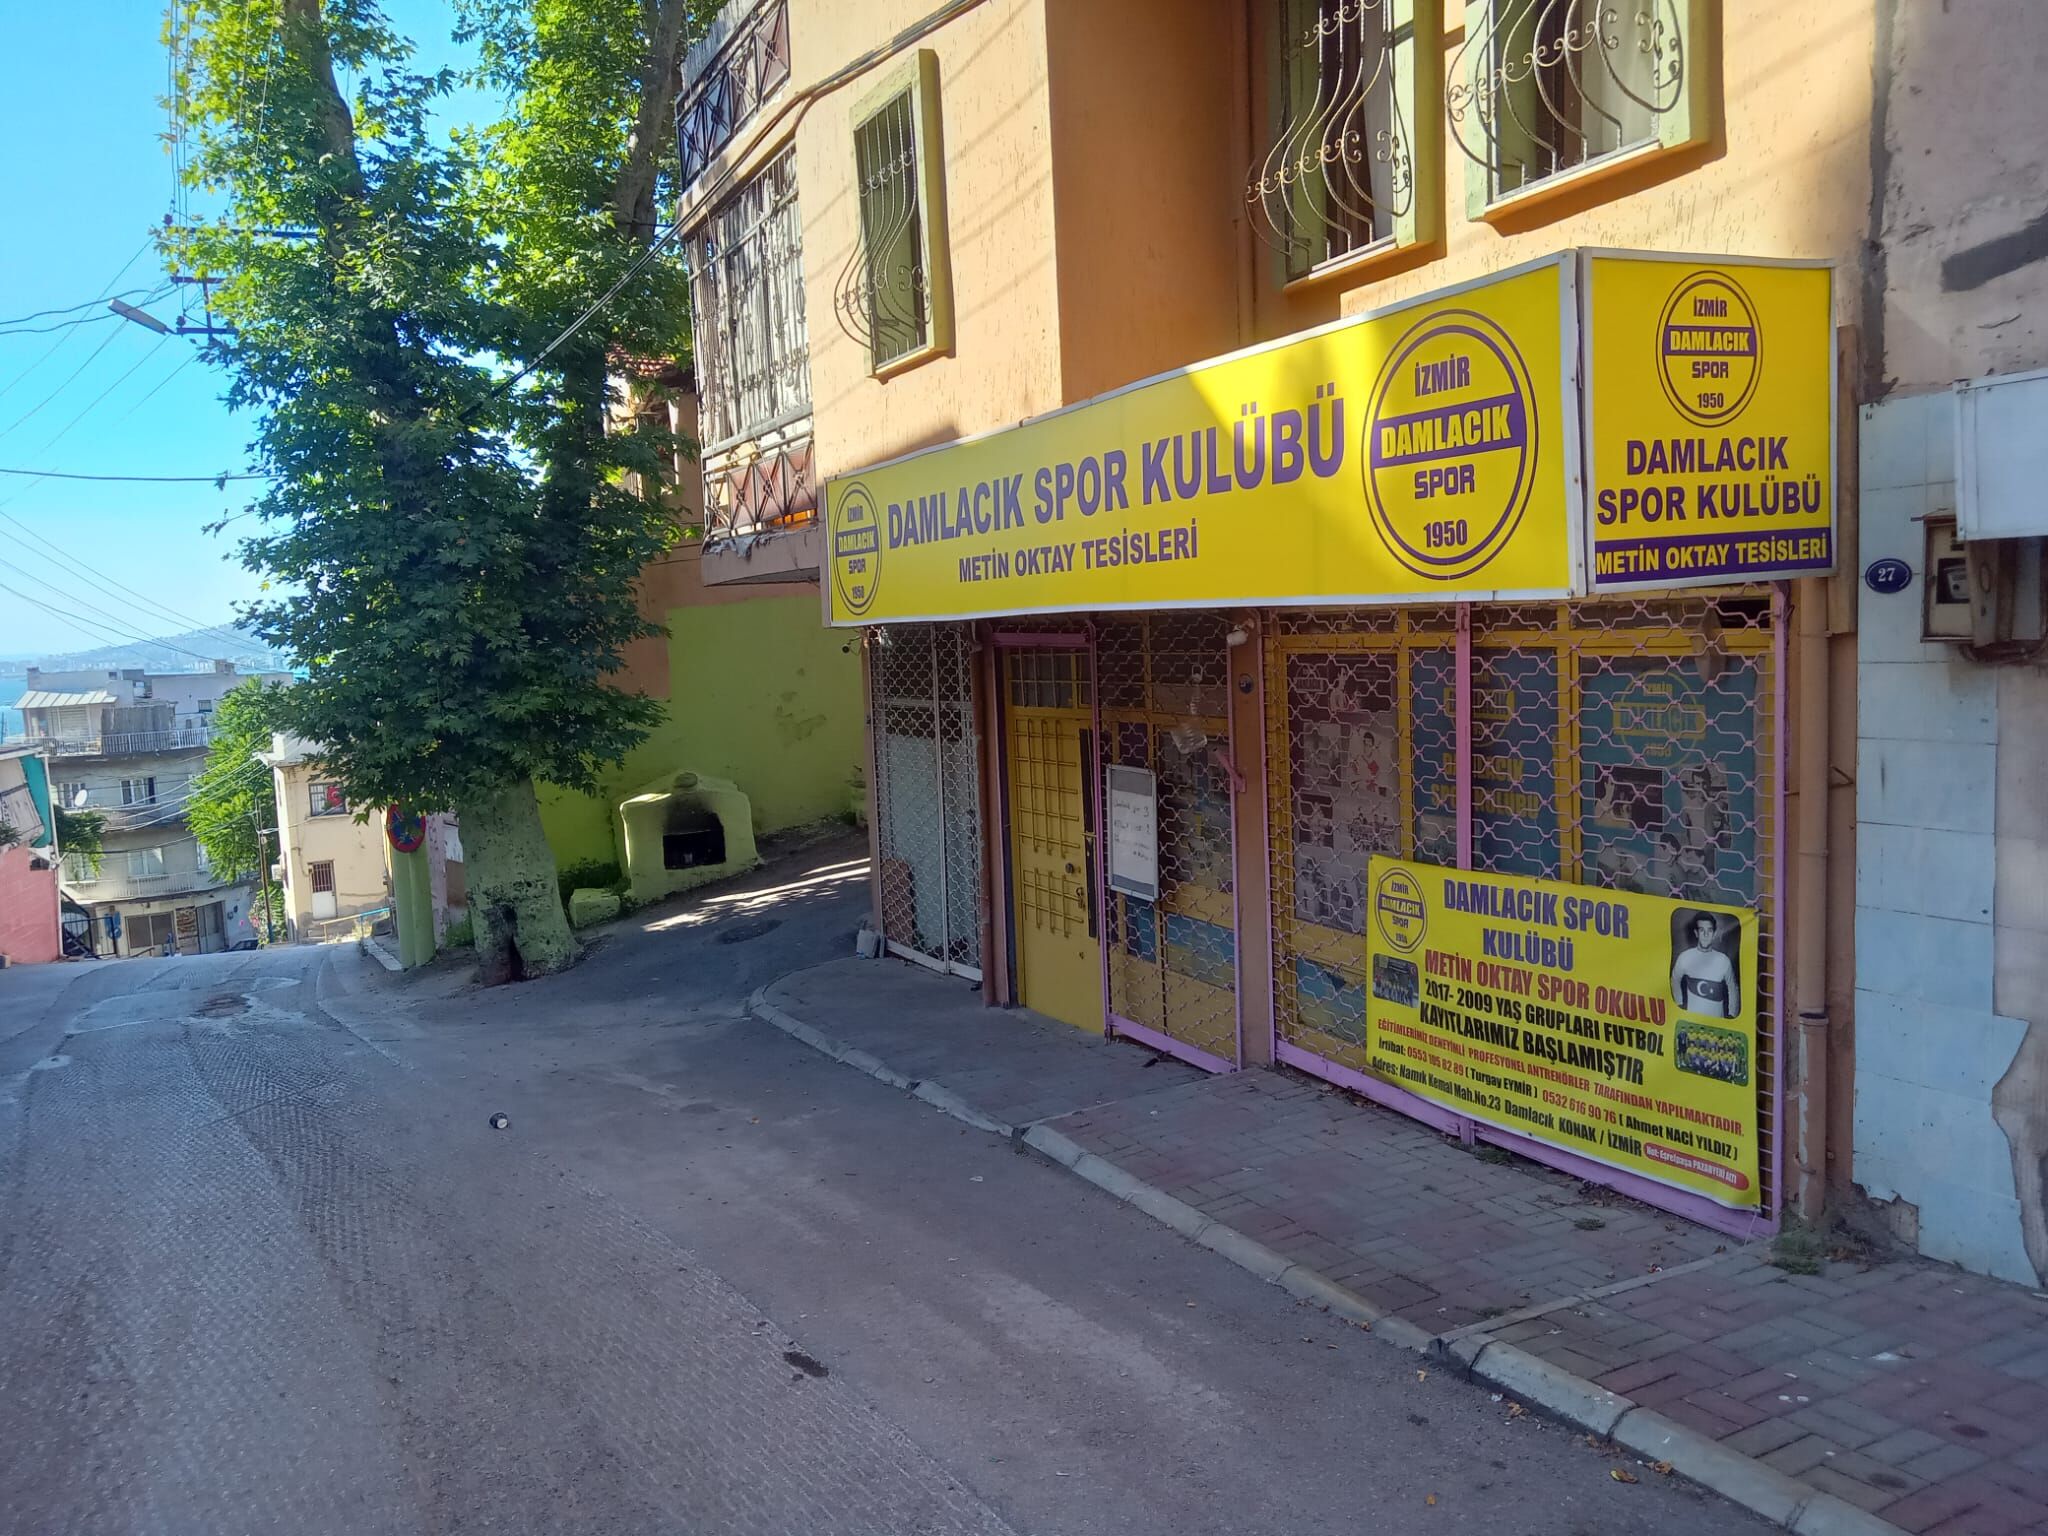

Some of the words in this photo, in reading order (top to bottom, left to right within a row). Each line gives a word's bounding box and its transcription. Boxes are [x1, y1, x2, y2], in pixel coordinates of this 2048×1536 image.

[1692, 295, 1728, 318] İZMİR
[1669, 329, 1750, 353] DAMLACIK
[1414, 352, 1471, 397] İZMİR
[1691, 360, 1729, 379] SPOR
[1696, 392, 1725, 409] 1950
[1380, 404, 1512, 460] DAMLACIK
[888, 473, 1025, 549] DAMLACIK
[1034, 449, 1127, 524] SPOR
[1142, 382, 1344, 505] KULÜBÜ
[1626, 436, 1789, 475] DAMLACIK
[1414, 464, 1475, 500] SPOR
[1597, 486, 1687, 526] SPOR
[1698, 473, 1821, 519] KULÜBÜ
[958, 545, 1009, 583] METİN
[1014, 543, 1076, 577] OKTAY
[1081, 517, 1199, 567] TESİSLERİ
[1423, 519, 1468, 548] 1950
[1596, 542, 1659, 575] METİN
[1665, 544, 1729, 568] OKTAY
[1736, 535, 1827, 564] TESİSLERİ
[848, 558, 867, 575] SPOR
[1877, 567, 1896, 582] 27
[1444, 879, 1558, 927] DAMLACIK
[1563, 896, 1630, 939] SPOR
[1483, 928, 1574, 971] KULÜBÜ
[1425, 949, 1472, 984] METİN
[1476, 961, 1533, 997] OKTAY
[1537, 973, 1590, 1010] SPOR
[1594, 986, 1666, 1026] OKULU
[1420, 1000, 1520, 1052] KAYITLARIMIZ
[1522, 1030, 1644, 1086] BAŞLAMIŞTIR
[1457, 988, 1493, 1014] 2009
[1495, 996, 1522, 1024] YAŞ
[1525, 1003, 1600, 1040] GRUPLARI
[1603, 1023, 1664, 1057] FUTBOL
[1407, 1045, 1427, 1063] 0553
[1453, 1062, 1464, 1076] 89
[1470, 1067, 1502, 1089] Turgay
[1503, 1077, 1532, 1097] EYMİR
[1542, 1089, 1568, 1109] 0532
[1569, 1098, 1586, 1115] 616
[1588, 1104, 1602, 1120] 90
[1602, 1109, 1617, 1125] 76
[1625, 1114, 1664, 1138] Ahmet
[1666, 1126, 1694, 1147] NACİ
[1696, 1134, 1732, 1160] YILDIZ
[1428, 1072, 1453, 1095] Kemal
[1504, 1099, 1555, 1130] Damlacık
[1559, 1117, 1597, 1143] KONAK
[1607, 1128, 1642, 1157] İZMİR
[1468, 1047, 1526, 1074] PROFESYONEL
[1527, 1063, 1590, 1092] ANTRENÖRLER
[1594, 1082, 1653, 1111] TARAFINDAN
[1655, 1099, 1744, 1137] YAPILMAKTADIR.
